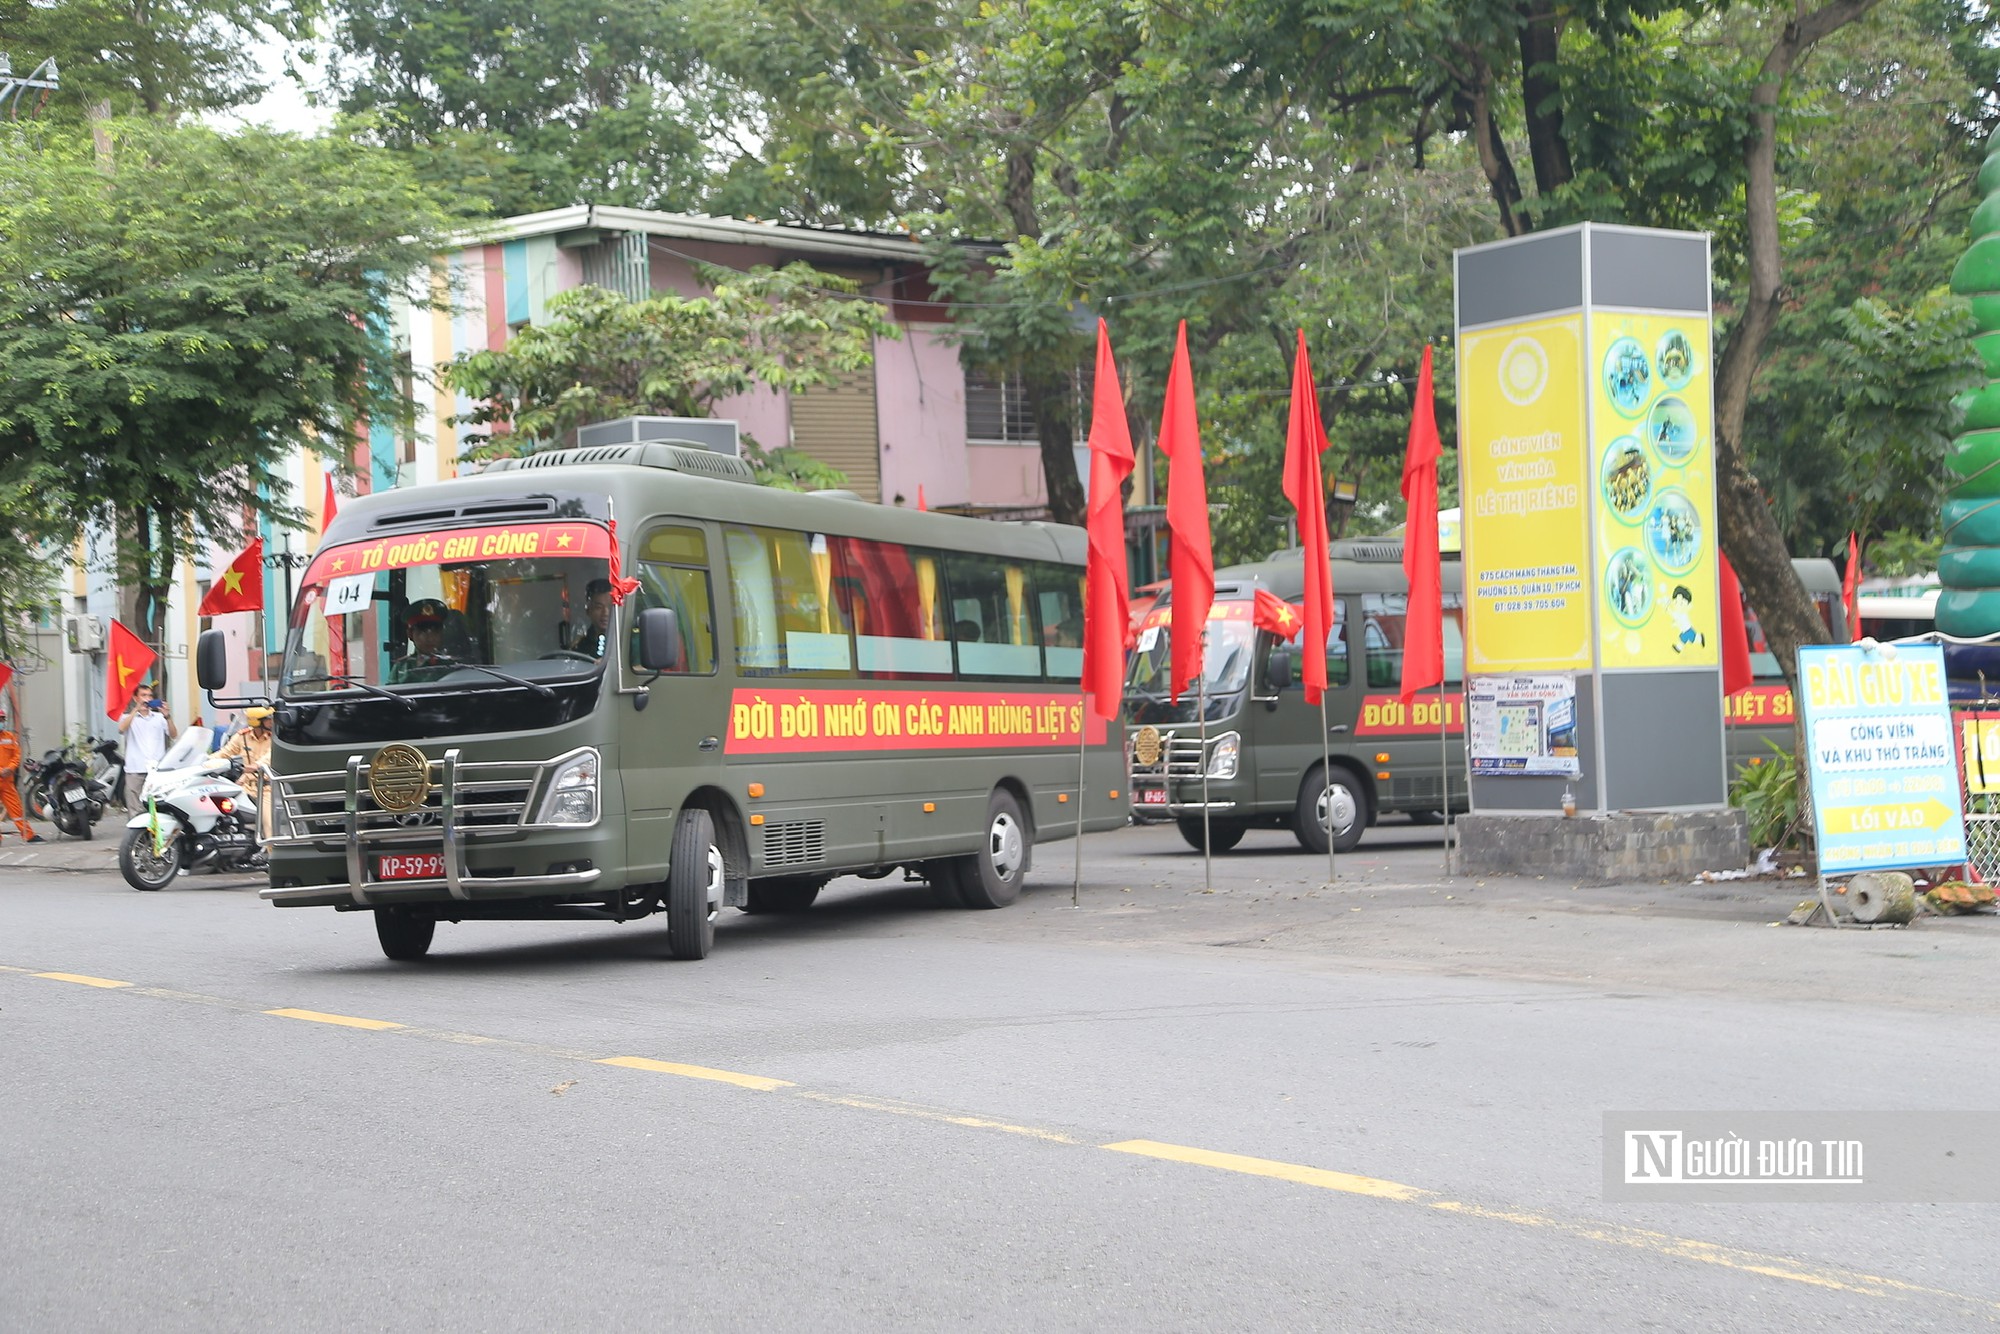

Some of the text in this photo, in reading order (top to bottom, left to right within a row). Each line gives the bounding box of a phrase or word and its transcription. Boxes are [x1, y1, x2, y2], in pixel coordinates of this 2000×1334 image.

[1490, 430, 1562, 458] CÔNG VIÊN
[1497, 460, 1525, 483] VĂN
[1476, 481, 1577, 518] LÊ THỊ RIÊNG
[360, 530, 539, 570] TỔ QUỐC GHI CÔNG
[338, 583, 360, 605] 04
[1807, 657, 1857, 707] BÃI
[1906, 662, 1942, 703] XE
[733, 695, 774, 739] ĐỜI
[780, 695, 819, 738] ĐỜI
[823, 697, 867, 737] NHỚ
[872, 701, 901, 736] ƠN
[905, 698, 944, 736] CÁC
[947, 705, 984, 735] ANH
[987, 699, 1033, 735] HÙNG
[1035, 699, 1067, 741] LIỆT
[1364, 698, 1405, 727] ĐỜI
[1850, 721, 1915, 741] CÔNG VIÊN
[1822, 747, 1841, 764] VÀ
[1845, 748, 1872, 762] KHU
[1904, 740, 1945, 760] TRẮNG
[1850, 805, 1925, 831] LỐI VÀO
